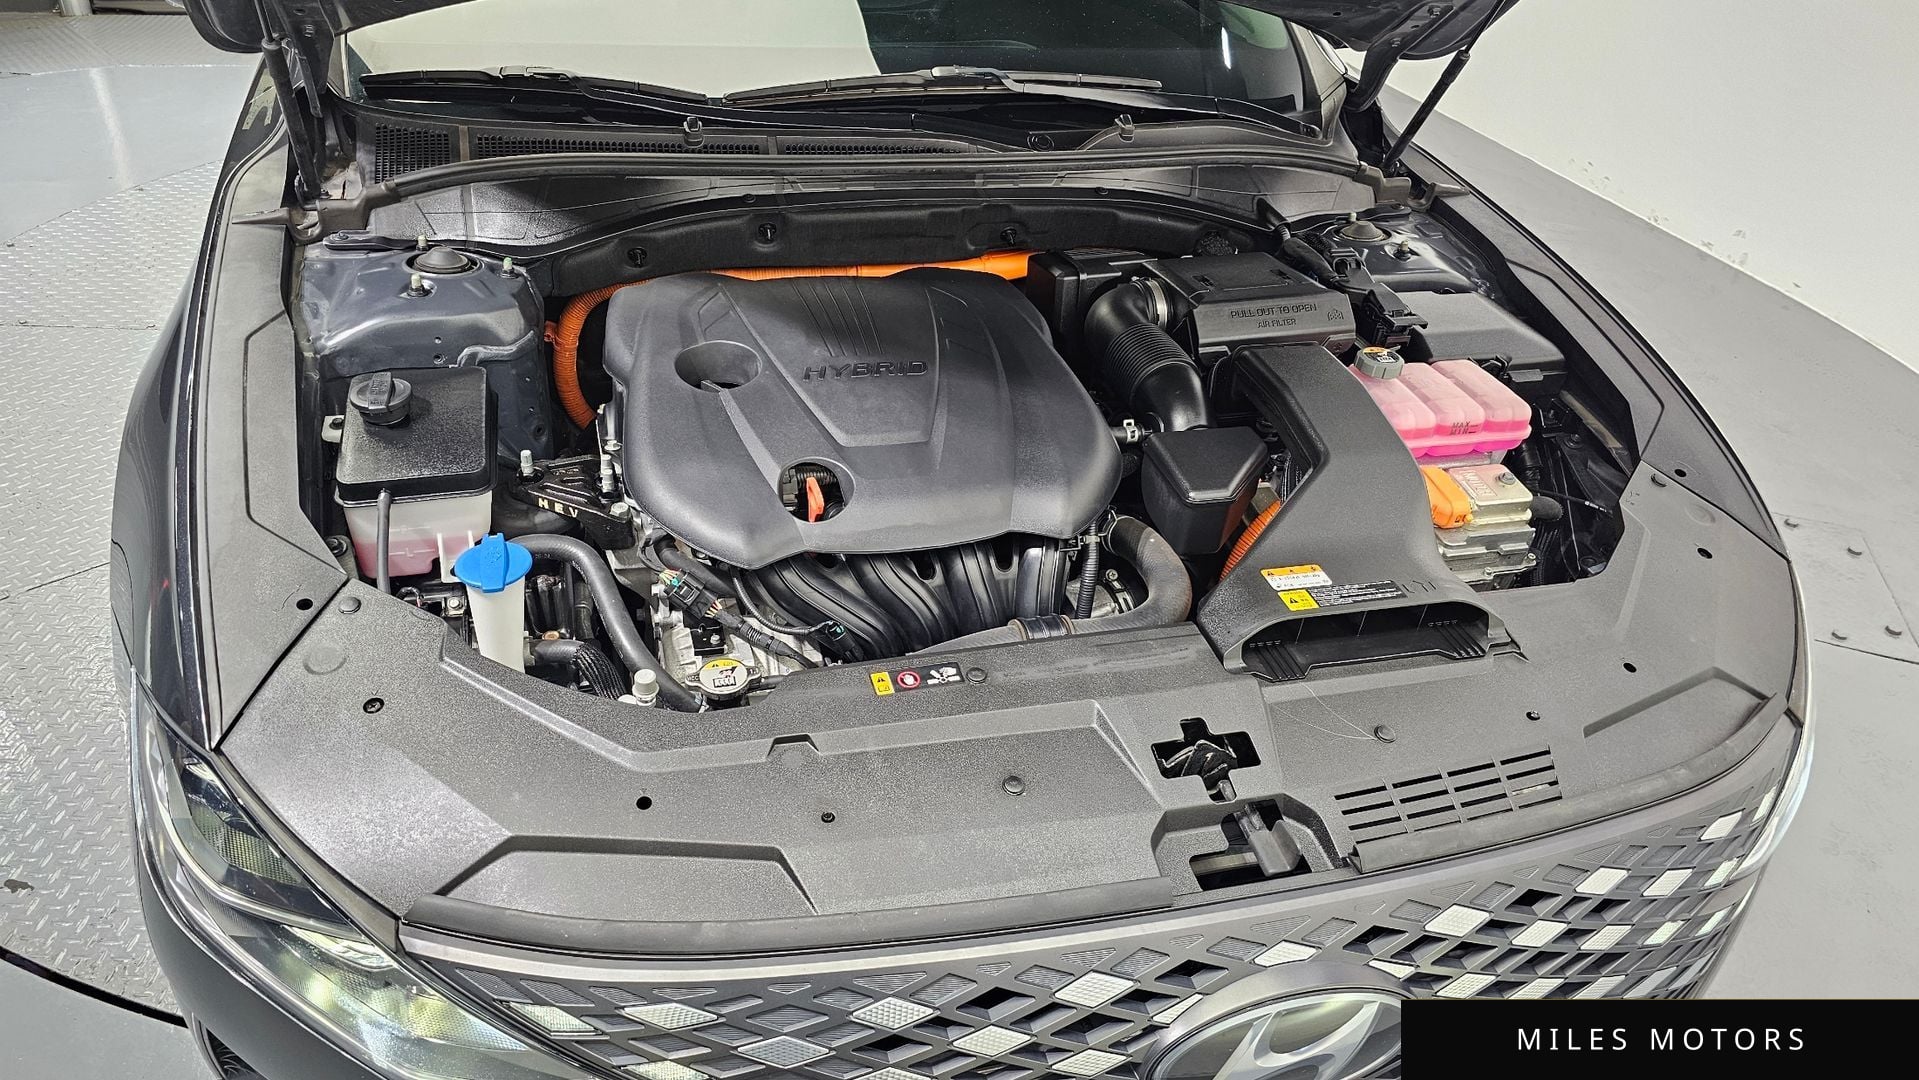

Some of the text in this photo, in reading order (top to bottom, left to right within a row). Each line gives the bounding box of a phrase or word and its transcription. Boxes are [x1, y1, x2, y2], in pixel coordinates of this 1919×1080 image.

[1230, 303, 1317, 318] PULL OUT TO OPEN
[1257, 318, 1297, 329] AIR FILTER
[803, 361, 928, 381] HYBRID
[1451, 421, 1471, 429] MAX
[1449, 428, 1469, 436] MIN
[538, 497, 579, 518] HEV
